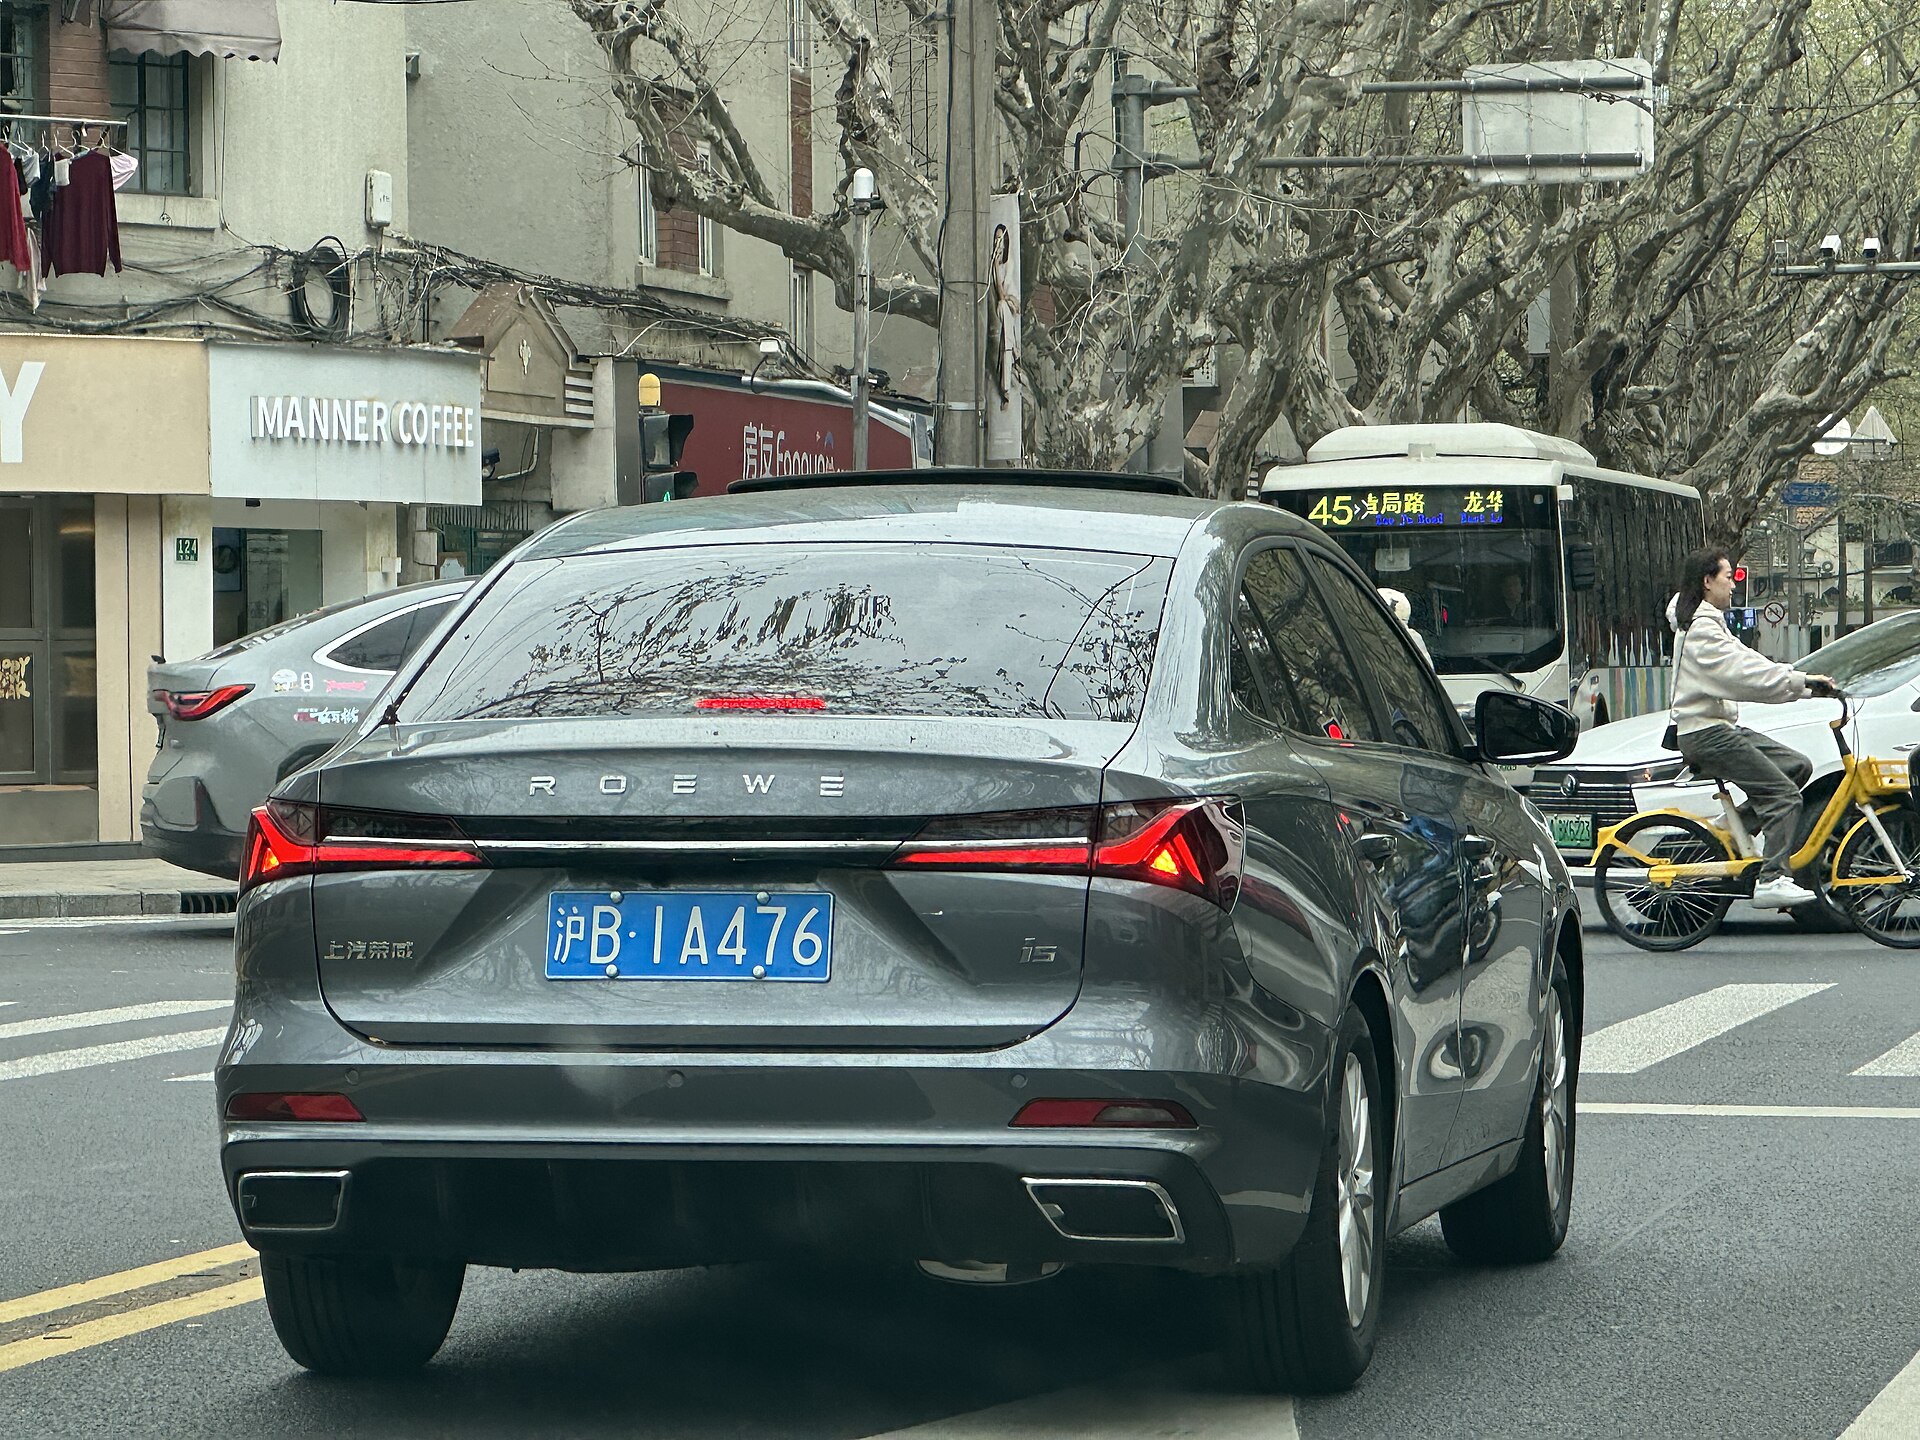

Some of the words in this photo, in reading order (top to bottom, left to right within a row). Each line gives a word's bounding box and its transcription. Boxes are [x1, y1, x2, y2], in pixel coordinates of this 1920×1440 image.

[251, 396, 388, 442] MANNER
[392, 401, 474, 447] COFFEE
[1308, 495, 1353, 526] 45
[1463, 490, 1503, 513] 龙华
[179, 539, 196, 554] 124
[529, 774, 844, 797] ROEWE
[324, 940, 414, 960] 上汽荣威
